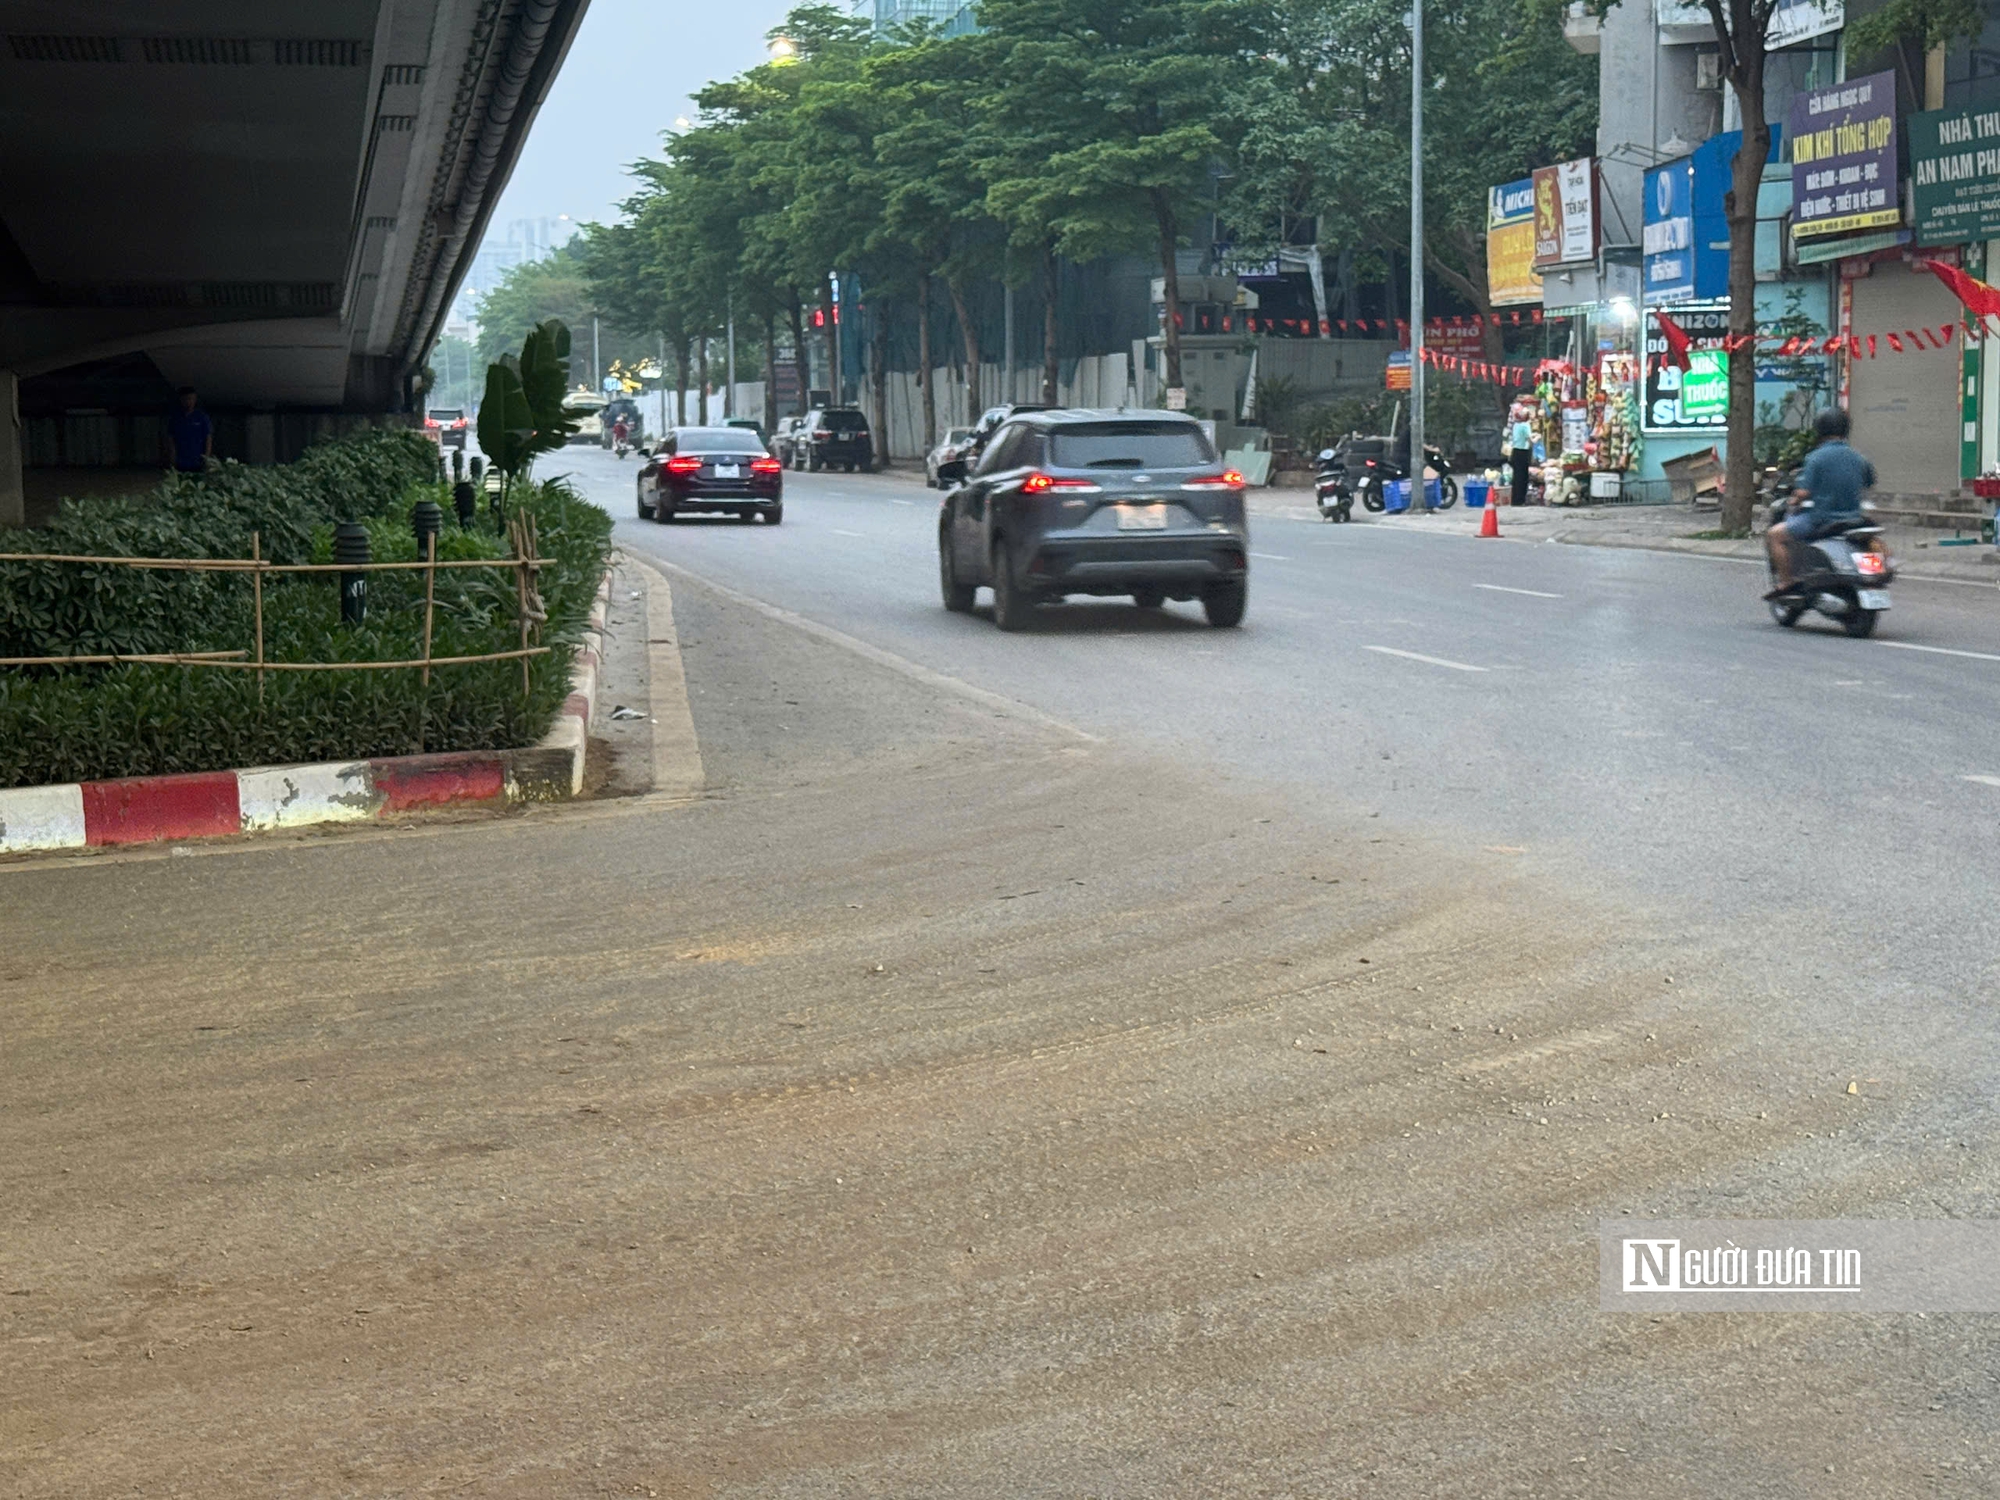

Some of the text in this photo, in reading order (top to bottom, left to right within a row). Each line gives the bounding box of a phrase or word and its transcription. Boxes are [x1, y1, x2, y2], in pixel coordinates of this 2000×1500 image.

[1793, 113, 1892, 165] KIM KHÍ TỔNG HỢP
[1939, 112, 1973, 145] NHÀ
[1917, 159, 1937, 186] AN
[1939, 152, 1974, 182] NAM
[1504, 188, 1534, 213] MICH
[1686, 377, 1728, 403] THUỐC
